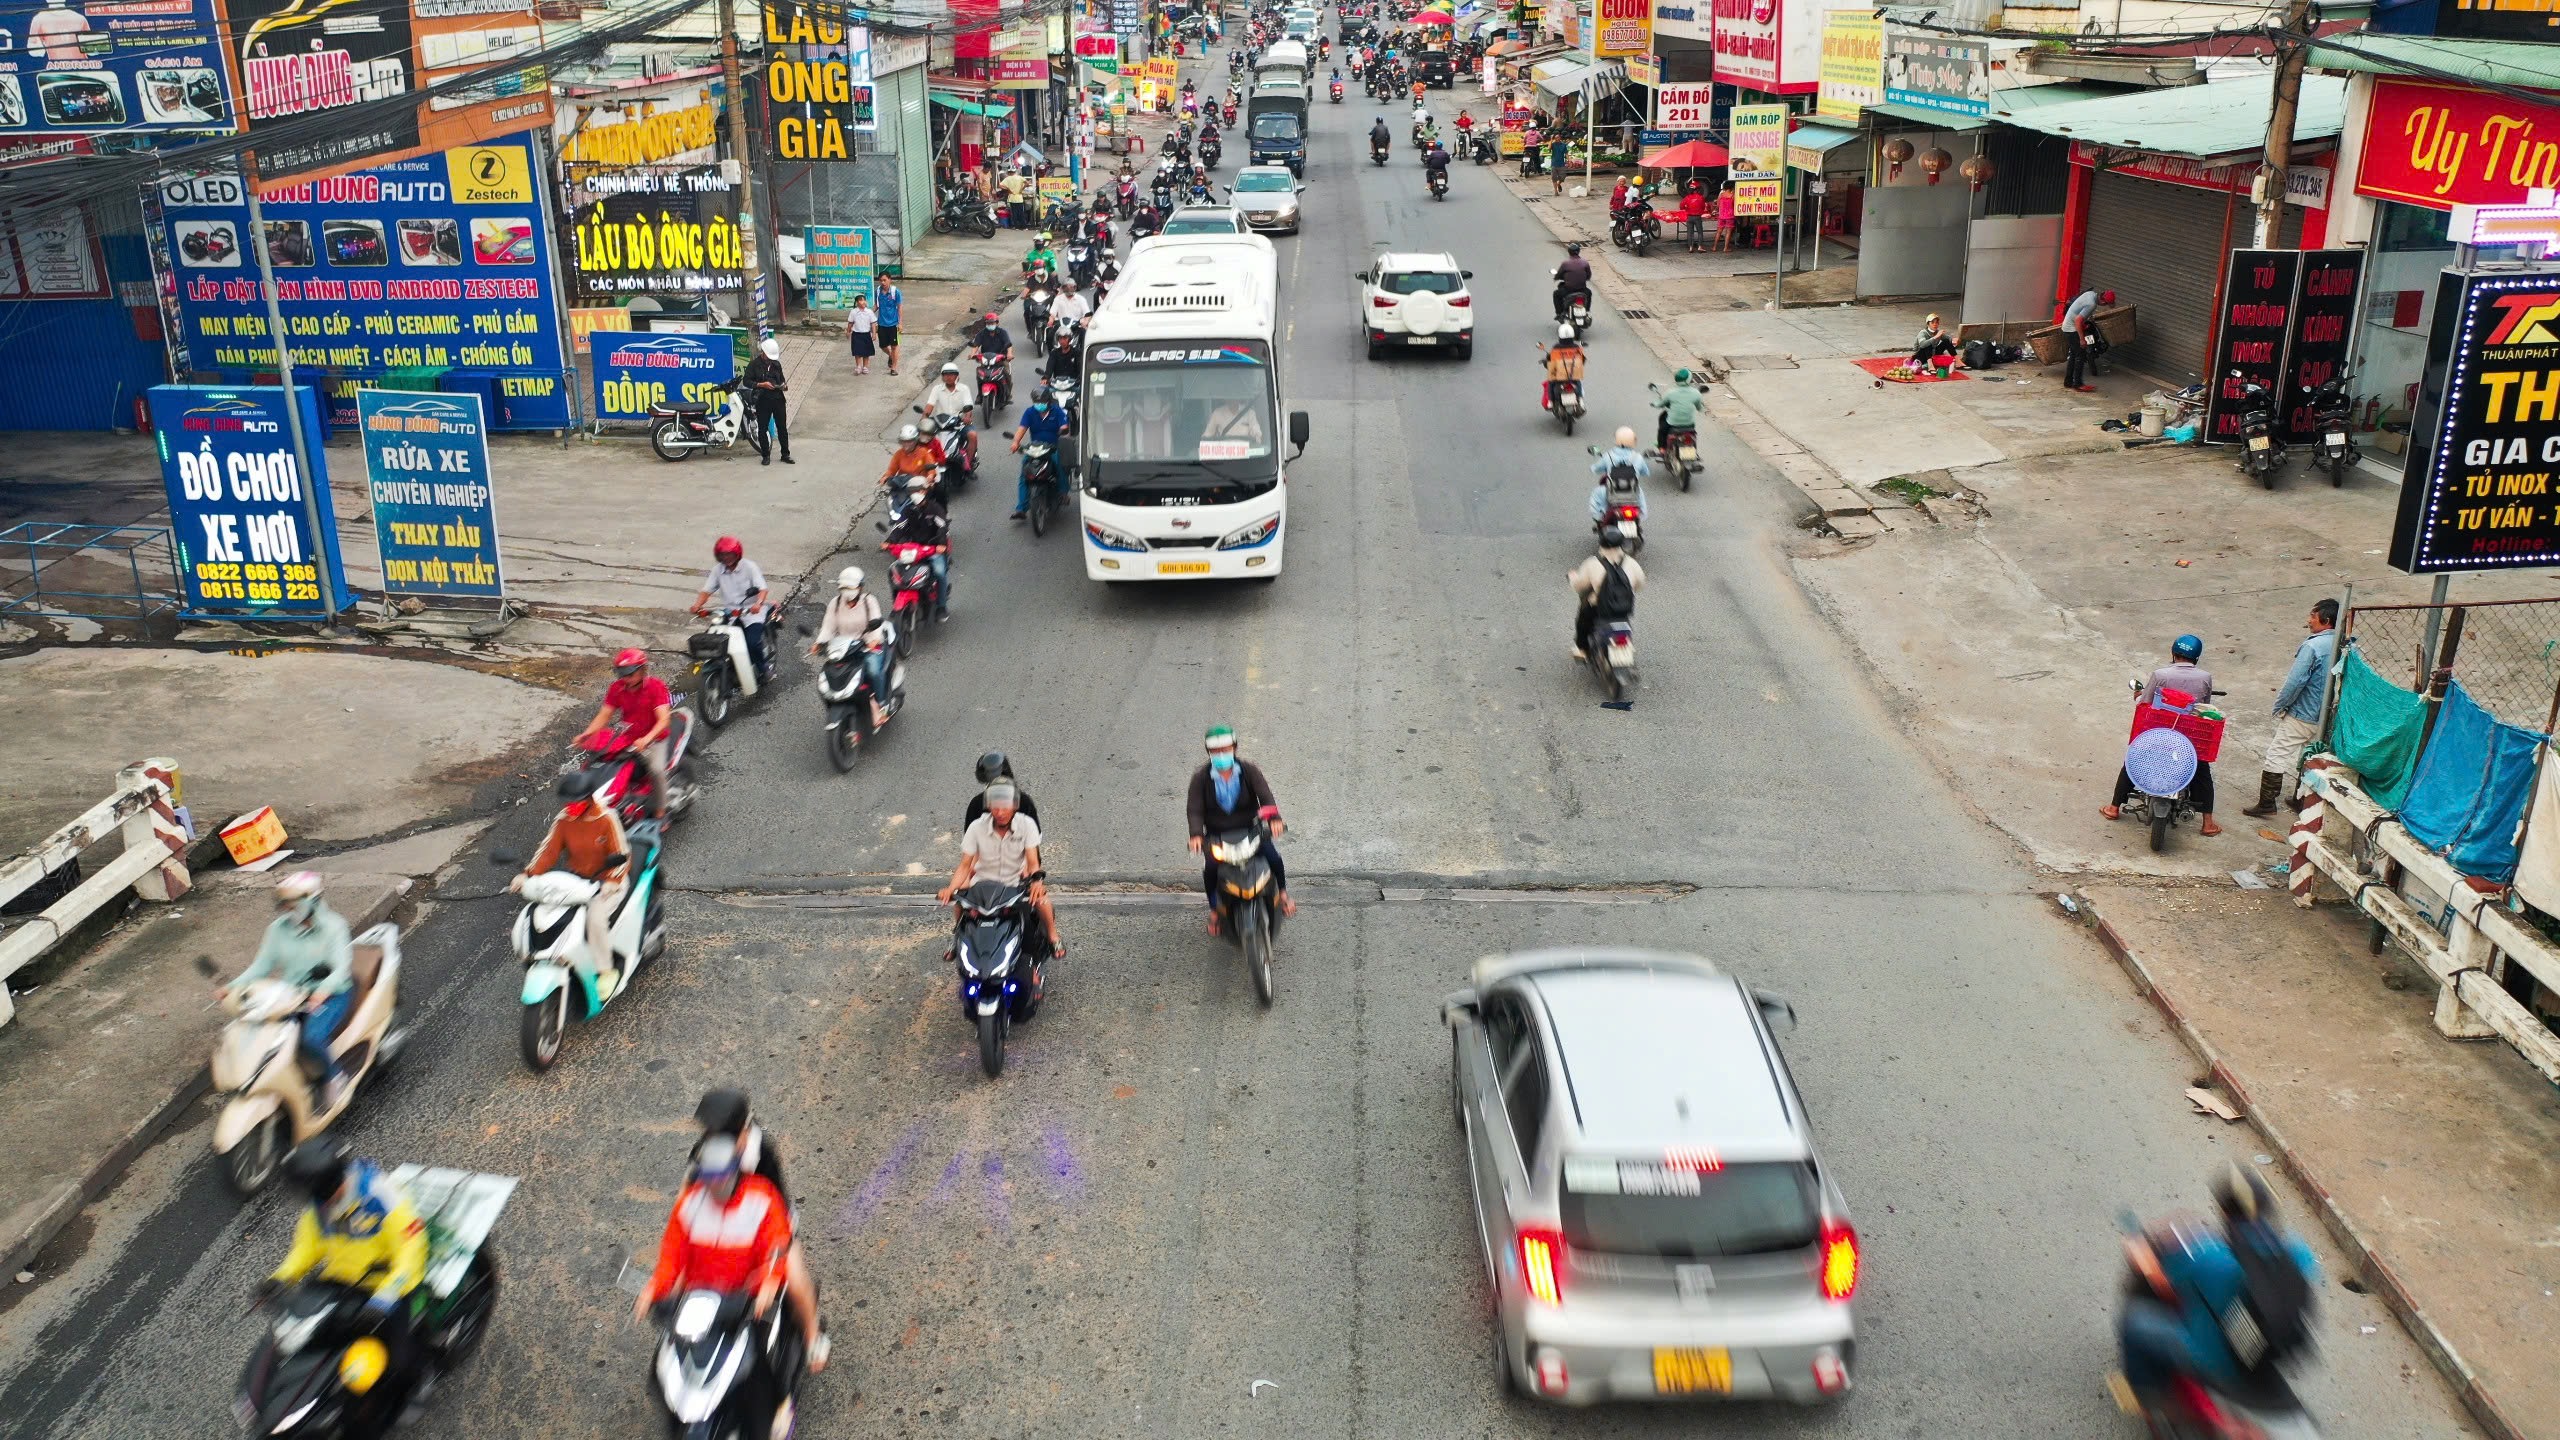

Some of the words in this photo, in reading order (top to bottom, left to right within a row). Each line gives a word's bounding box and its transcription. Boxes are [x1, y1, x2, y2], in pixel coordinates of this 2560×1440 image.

[47, 61, 103, 70] ANDROID
[769, 51, 849, 103] ÔNG
[1660, 86, 1690, 105] CẦM
[1692, 85, 1710, 105] ĐỒ
[1668, 109, 1700, 121] 201
[1760, 113, 1781, 126] BÓP
[779, 109, 848, 159] GIÀ
[1734, 131, 1780, 149] MASSAGE
[2405, 106, 2469, 194] Uy
[586, 173, 626, 193] CHÍNH
[629, 172, 660, 195] HIỆU
[663, 172, 682, 195] HỆ
[685, 170, 730, 193] THỐNG
[2164, 162, 2184, 178] CHO
[166, 181, 238, 204] OLED
[381, 182, 445, 202] AUTO
[466, 189, 518, 200] Zestech
[1739, 186, 1758, 200] DIỆT
[1759, 185, 1777, 197] MỐI
[1737, 202, 1753, 213] CÔN
[1753, 201, 1779, 213] TRÙNG
[625, 212, 655, 270] BÒ
[660, 210, 703, 270] ÔNG
[834, 229, 863, 248] THẤT
[840, 250, 870, 269] QUÂN
[590, 277, 614, 291] CÁC
[618, 276, 645, 290] MÓN
[717, 274, 743, 289] DÂN
[2254, 260, 2277, 289] TỦ
[2307, 264, 2355, 297] CÁNH
[187, 273, 221, 302] LẮP
[223, 276, 257, 305] ĐẶT
[303, 276, 347, 302] HÌNH
[348, 279, 383, 301] DVD
[387, 279, 461, 300] ANDROID
[464, 278, 539, 299] ZESTECH
[200, 316, 229, 336] MAY
[233, 312, 267, 340] MỆN
[291, 316, 320, 336] CAO
[322, 310, 351, 336] CẤP
[365, 309, 394, 335] PHỦ
[397, 314, 461, 334] CERAMIC
[473, 308, 502, 334] PHỦ
[506, 307, 538, 334] GẦM
[2230, 301, 2286, 327] NHÔM
[2303, 310, 2345, 343] KÍNH
[329, 343, 370, 371] NHIỆT
[383, 343, 422, 366] CÁCH
[425, 343, 449, 366] ÂM
[460, 340, 509, 366] CHỐNG
[511, 339, 533, 365] ỒN
[610, 349, 645, 367] HÙNG
[646, 350, 680, 368] DŨNG
[680, 357, 715, 369] AUTO
[1123, 350, 1185, 363] ALLERGO
[2231, 341, 2274, 364] INOX
[2299, 361, 2335, 388] CAO
[602, 370, 666, 414] ĐỒNG
[243, 421, 278, 433] AUTO
[368, 413, 403, 432] HÙNG
[405, 414, 440, 433] DŨNG
[440, 422, 476, 435] AUTO
[382, 440, 434, 473] RỬA
[438, 449, 471, 473] XE
[2464, 438, 2528, 466] GIA
[177, 435, 223, 501] ĐỒ
[227, 449, 302, 502] CHƠI
[373, 478, 432, 505] CHUYÊN
[434, 480, 488, 512] NGHIỆP
[2466, 468, 2493, 497] TỦ
[2496, 472, 2550, 496] INOX
[1161, 497, 1201, 506] ISUZU
[2457, 506, 2488, 530] TƯ
[2489, 499, 2534, 529] VẤN
[199, 513, 244, 562] XE
[246, 510, 302, 563] HƠI
[391, 523, 439, 546] THAY
[443, 515, 481, 548] DẦU
[196, 563, 242, 581] 0822
[244, 563, 280, 581] 666
[283, 564, 317, 582] 368
[422, 556, 450, 589] NỘI
[452, 553, 495, 585] THẤT
[200, 581, 245, 599] 0815
[248, 582, 283, 600] 666
[286, 583, 320, 600] 226
